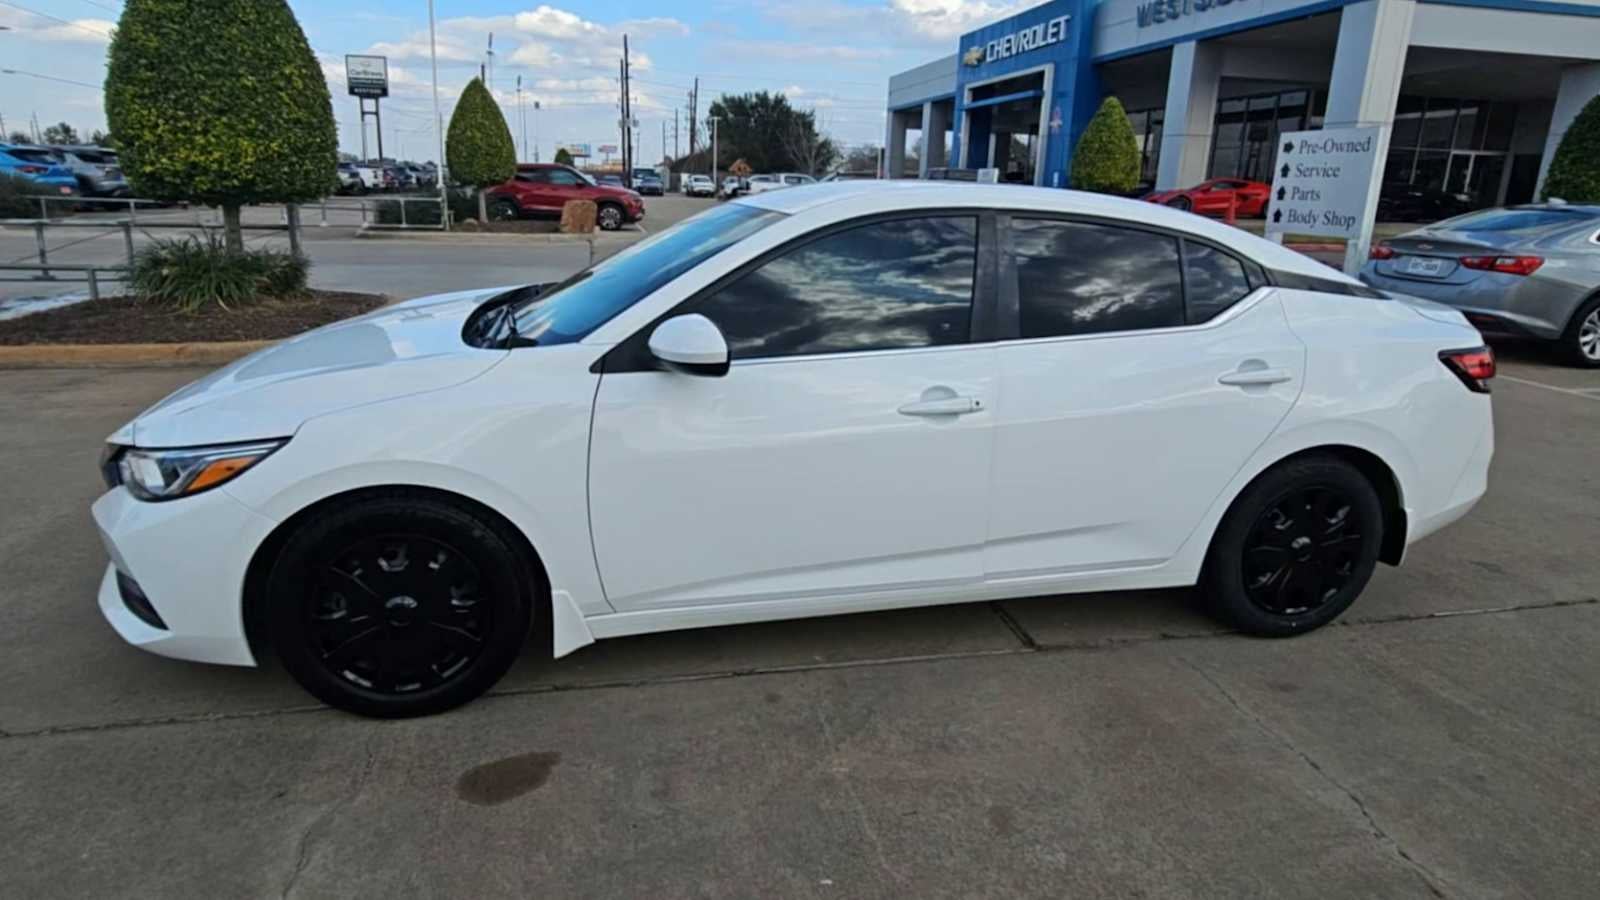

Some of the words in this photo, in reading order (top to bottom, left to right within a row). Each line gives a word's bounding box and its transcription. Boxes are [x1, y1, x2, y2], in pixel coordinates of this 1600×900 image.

[985, 14, 1072, 62] CHEVROLET
[1298, 136, 1371, 154] Pre-Owned
[1295, 162, 1341, 178] Service
[1291, 186, 1321, 201] Parts
[1287, 208, 1320, 229] Body
[1322, 209, 1356, 230] Shop
